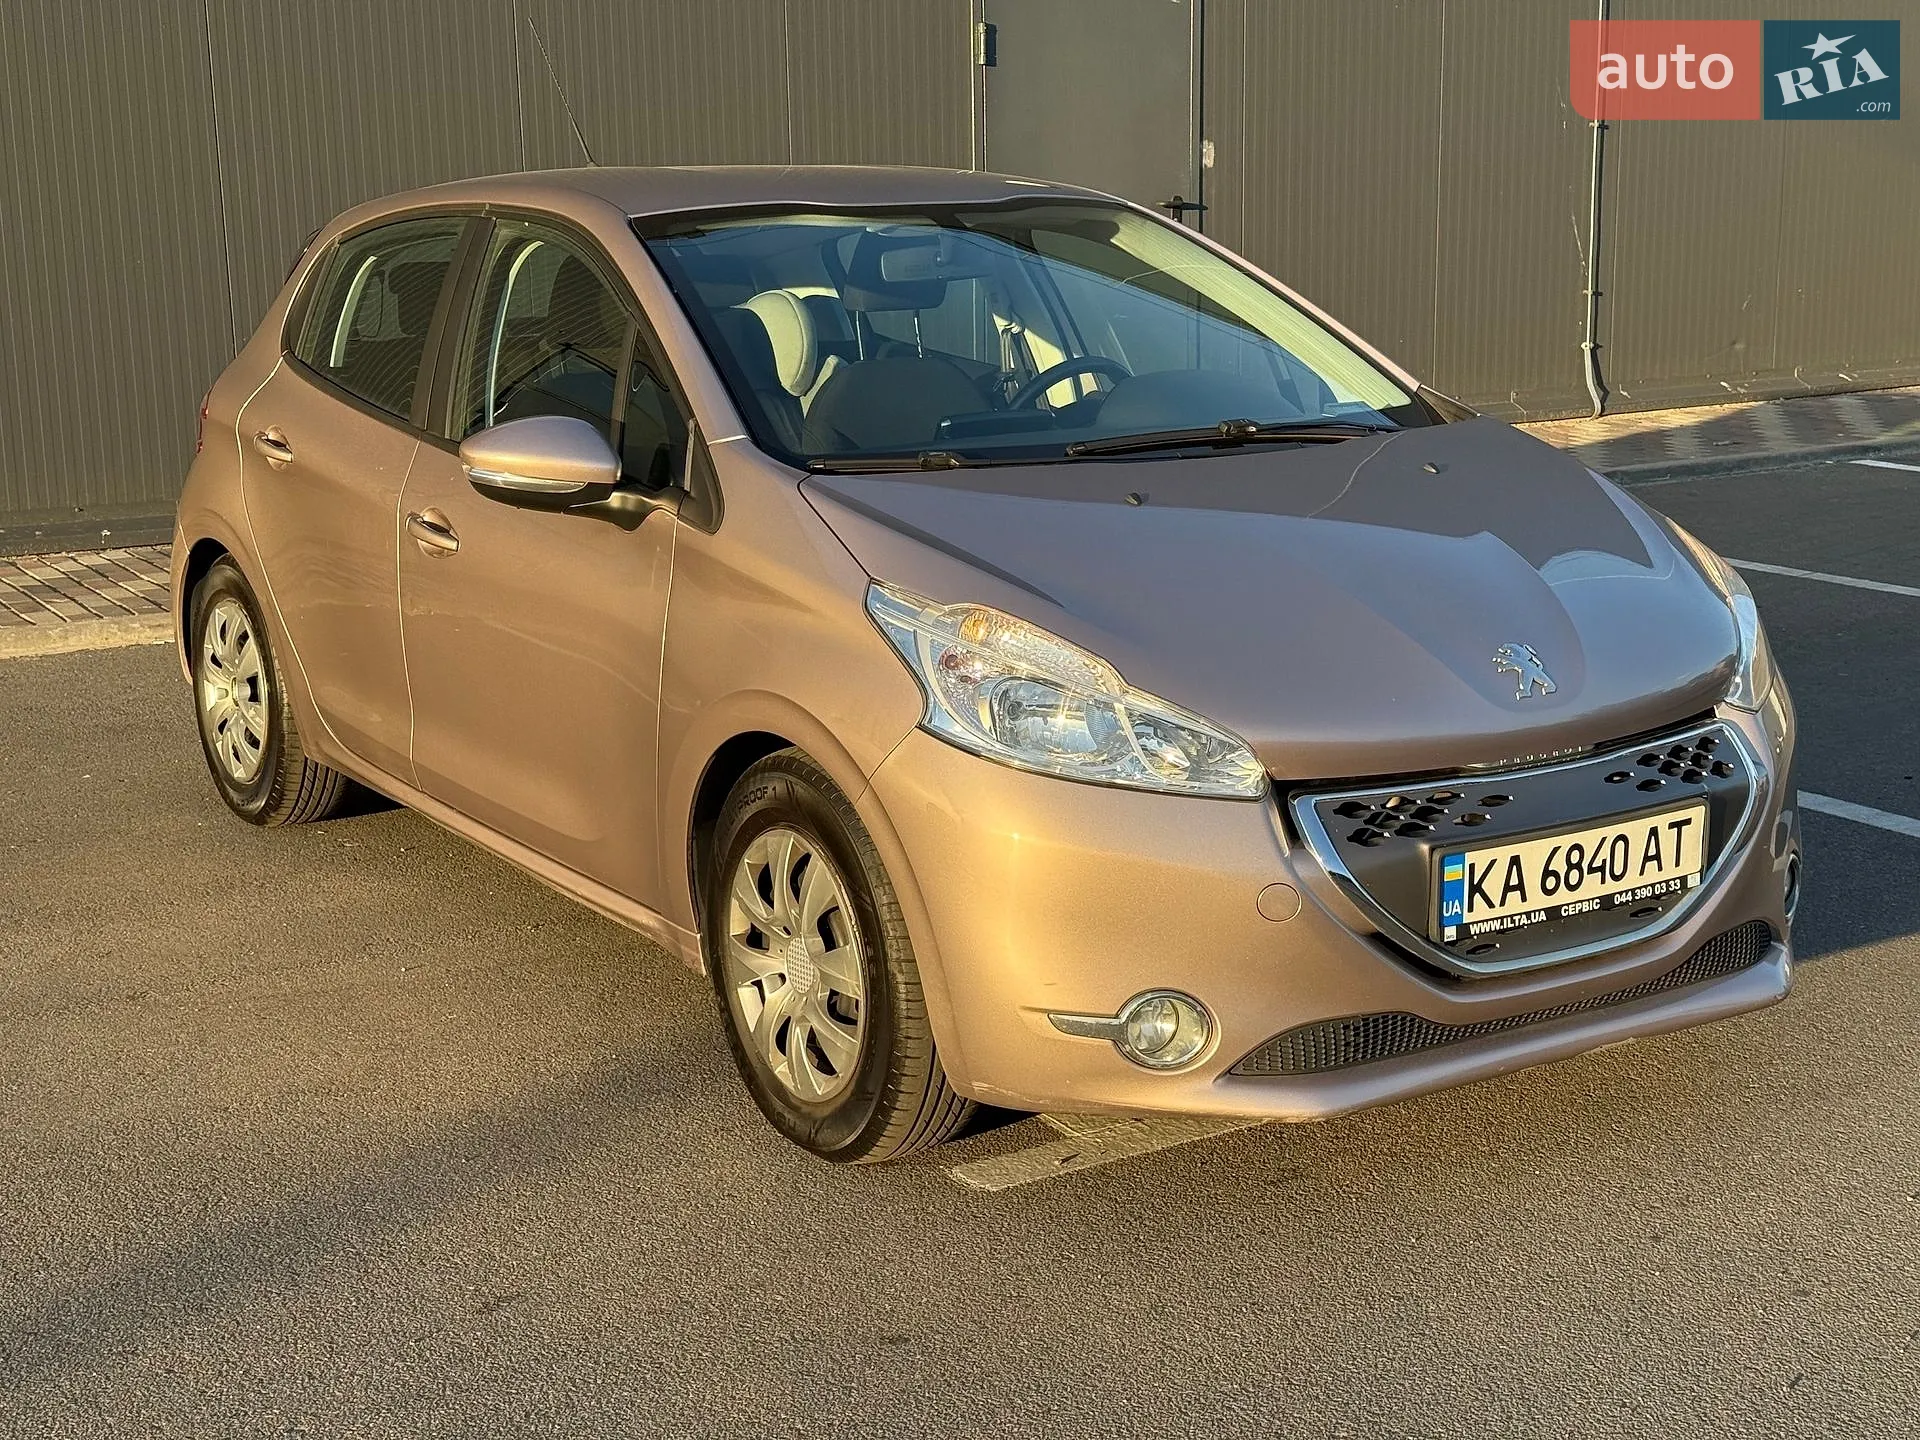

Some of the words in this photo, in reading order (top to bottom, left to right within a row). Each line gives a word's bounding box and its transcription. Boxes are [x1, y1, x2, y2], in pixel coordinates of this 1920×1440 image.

[1467, 854, 1528, 913] KA
[1540, 833, 1630, 897] 6840
[1639, 817, 1692, 877] AT
[1443, 899, 1461, 917] UA
[1469, 910, 1547, 935] WWW.ILTA.UA
[1614, 890, 1632, 905] 044
[1634, 886, 1652, 900] 390
[1654, 882, 1666, 895] 03
[1668, 879, 1681, 891] 33
